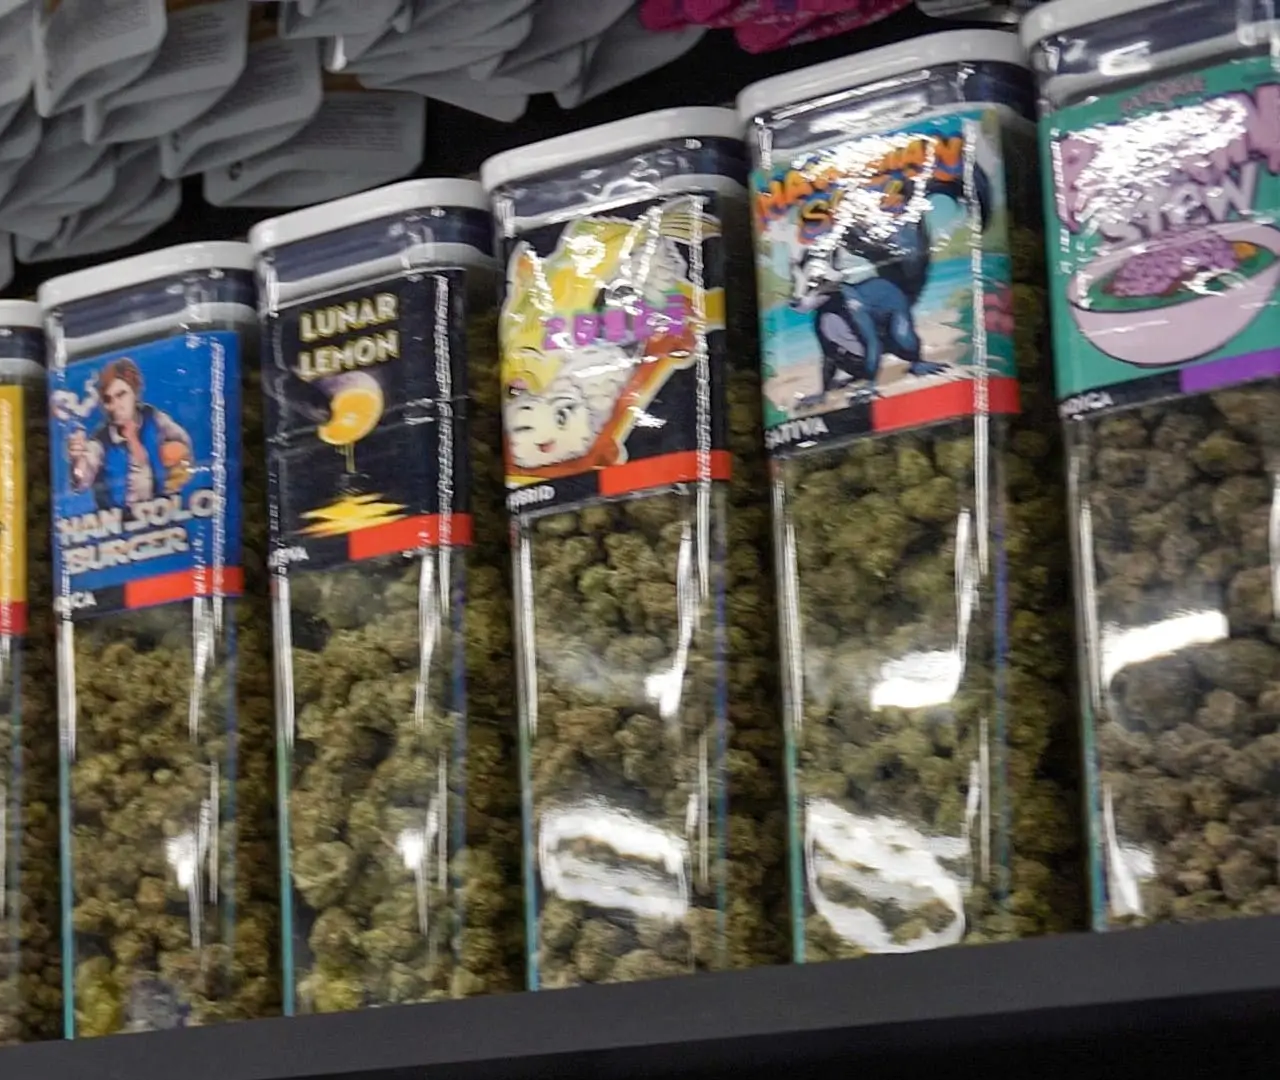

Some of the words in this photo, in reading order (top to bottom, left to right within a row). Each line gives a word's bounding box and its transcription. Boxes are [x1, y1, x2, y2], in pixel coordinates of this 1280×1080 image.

[298, 292, 399, 343] LUNAR
[297, 329, 401, 382] LEMON
[56, 507, 124, 547] HAN
[124, 487, 219, 533] SOLO
[62, 527, 190, 575] BURGER
